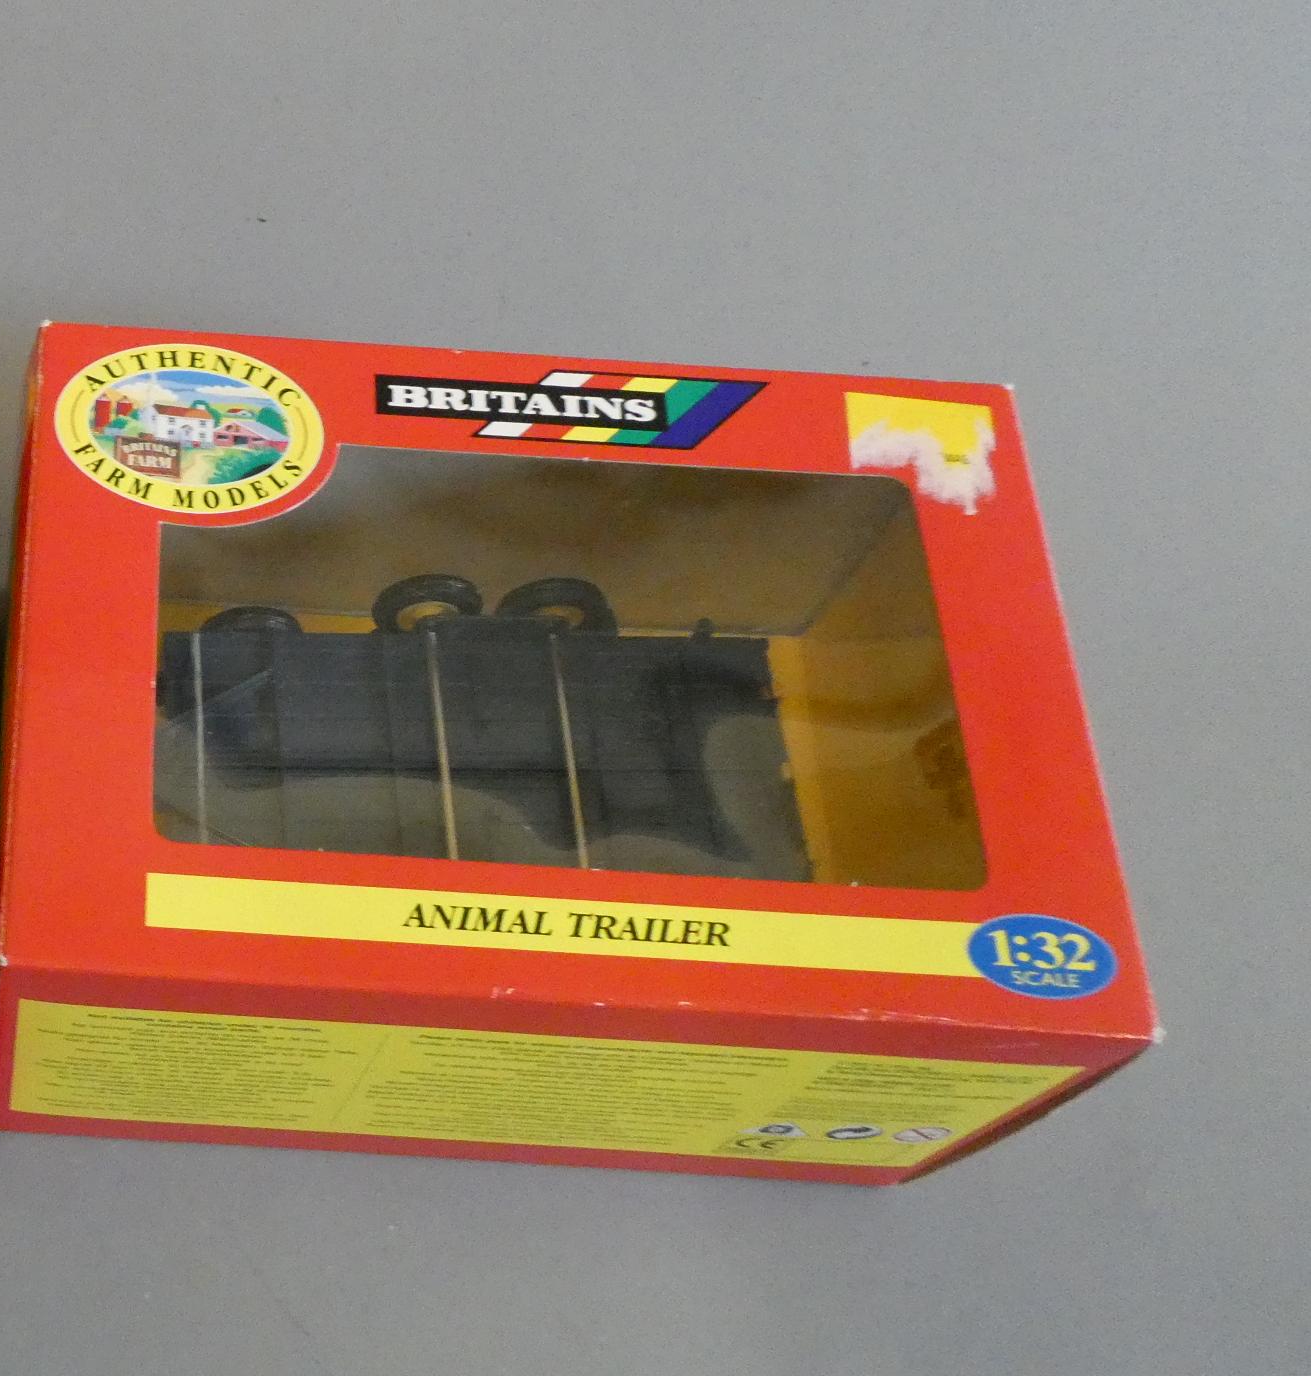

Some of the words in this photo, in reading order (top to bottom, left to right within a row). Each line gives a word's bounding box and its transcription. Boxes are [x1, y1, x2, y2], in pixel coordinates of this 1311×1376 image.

[85, 350, 301, 407] AUTHENTIC
[387, 384, 658, 422] BRITAINS
[73, 443, 154, 501] FARM
[172, 459, 303, 509] MODELS
[402, 902, 553, 937] ANIMAL
[568, 911, 731, 948] TRAILER
[987, 929, 1097, 972] 1:32
[1011, 970, 1081, 988] SCALE
